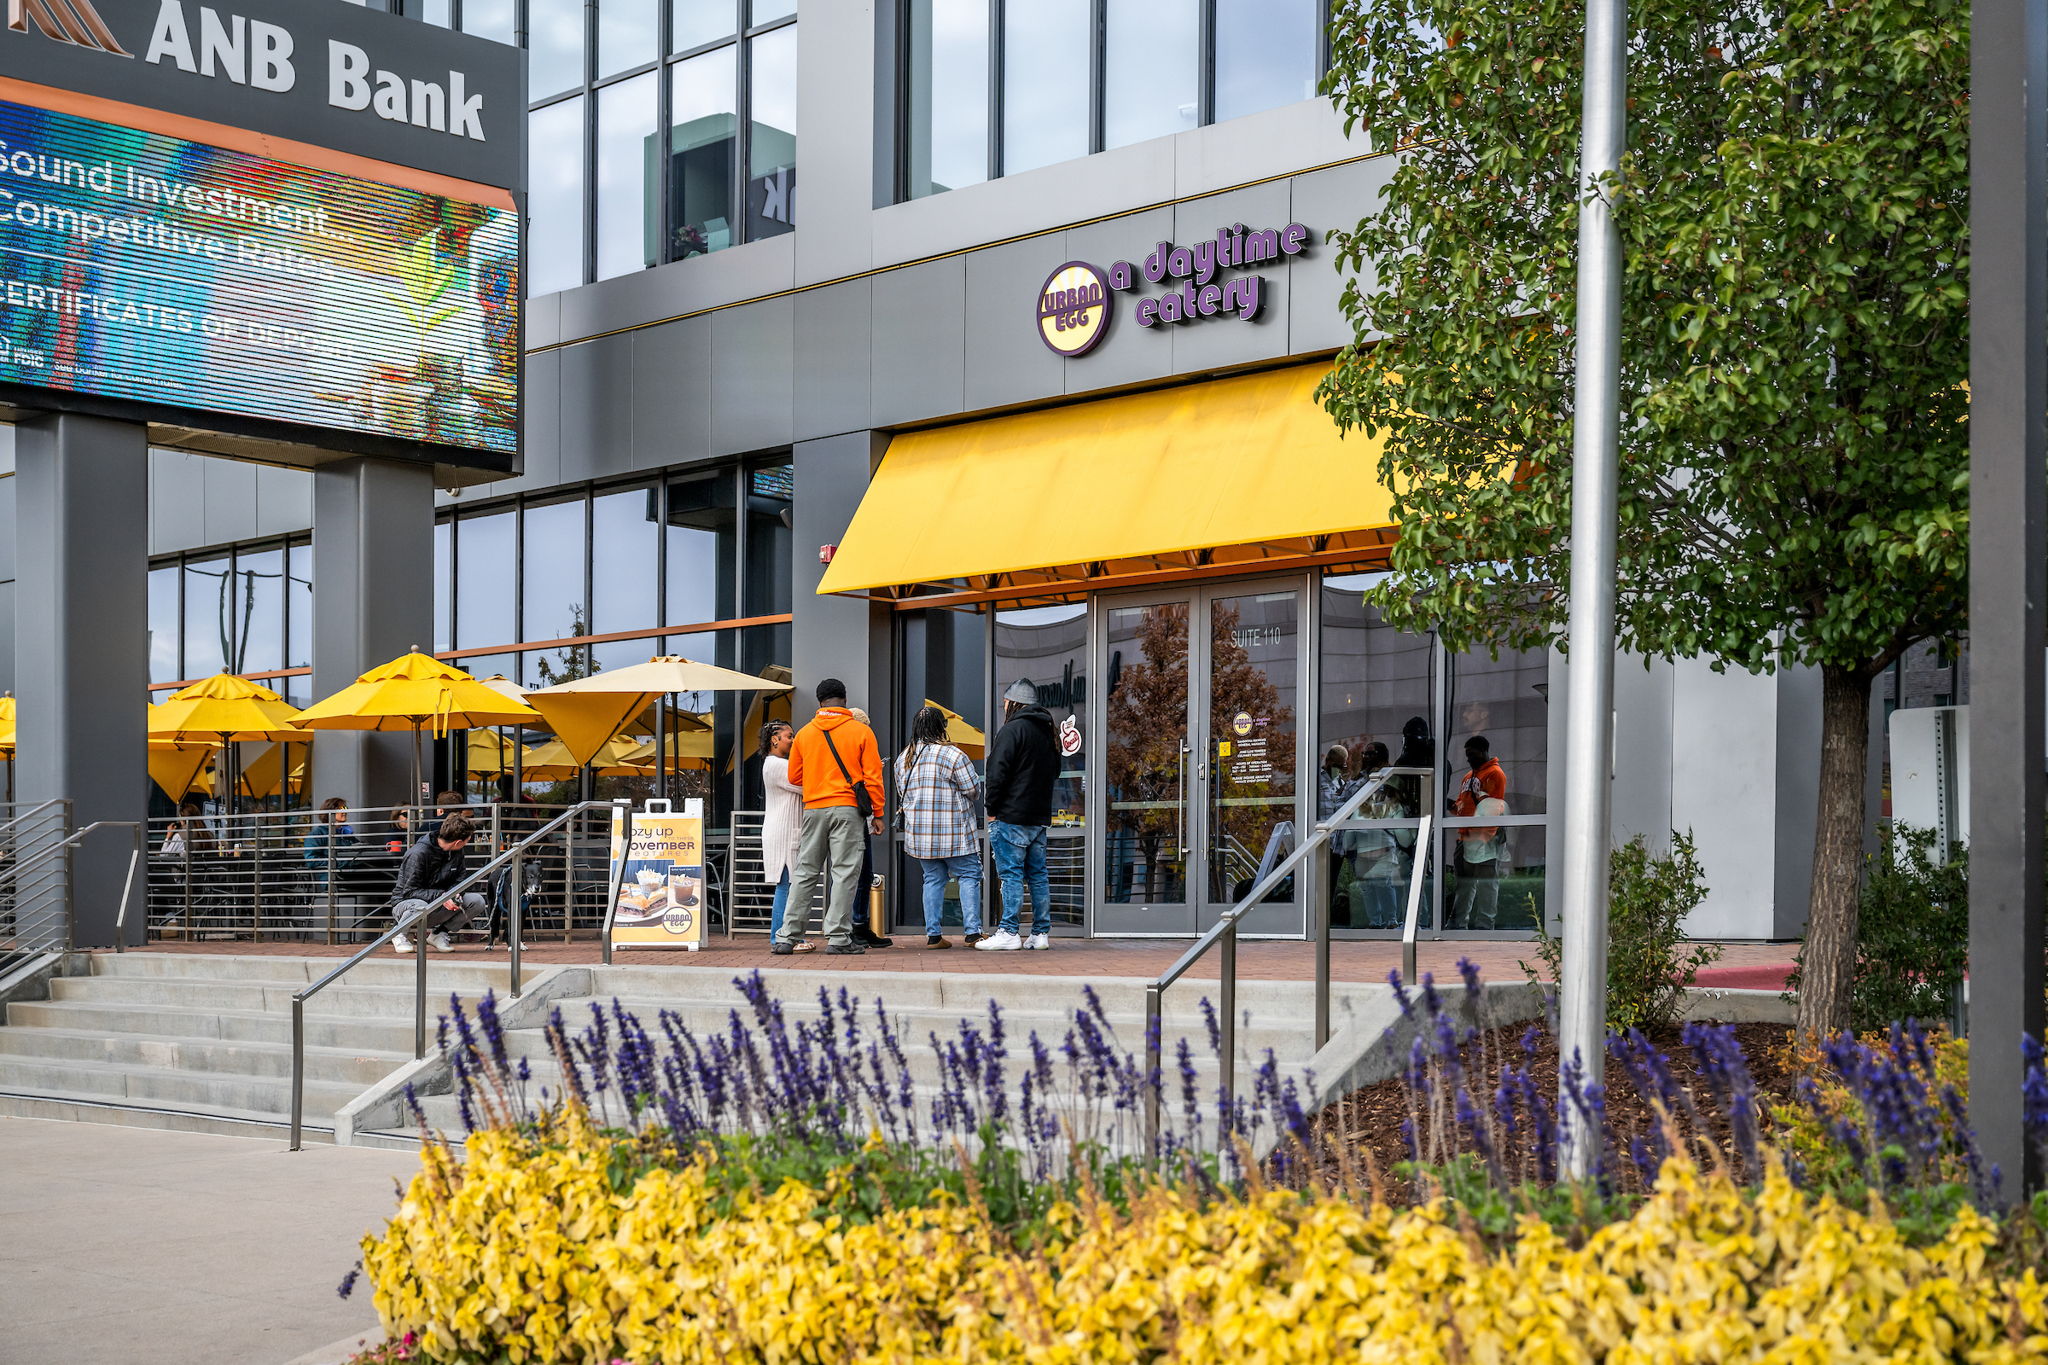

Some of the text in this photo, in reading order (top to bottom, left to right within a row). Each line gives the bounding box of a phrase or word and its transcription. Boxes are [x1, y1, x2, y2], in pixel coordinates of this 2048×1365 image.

[145, 0, 486, 142] ANB Bank
[238, 234, 336, 281] Rates
[1108, 223, 1308, 291] a daytime
[0, 279, 193, 333] ERTIFICATES
[1045, 282, 1100, 312] URBAN
[1135, 275, 1262, 328] eatery
[1055, 308, 1089, 331] EGG
[14, 353, 44, 368] FDIC
[1231, 627, 1281, 648] SUITE 110
[621, 827, 674, 839] ozy up
